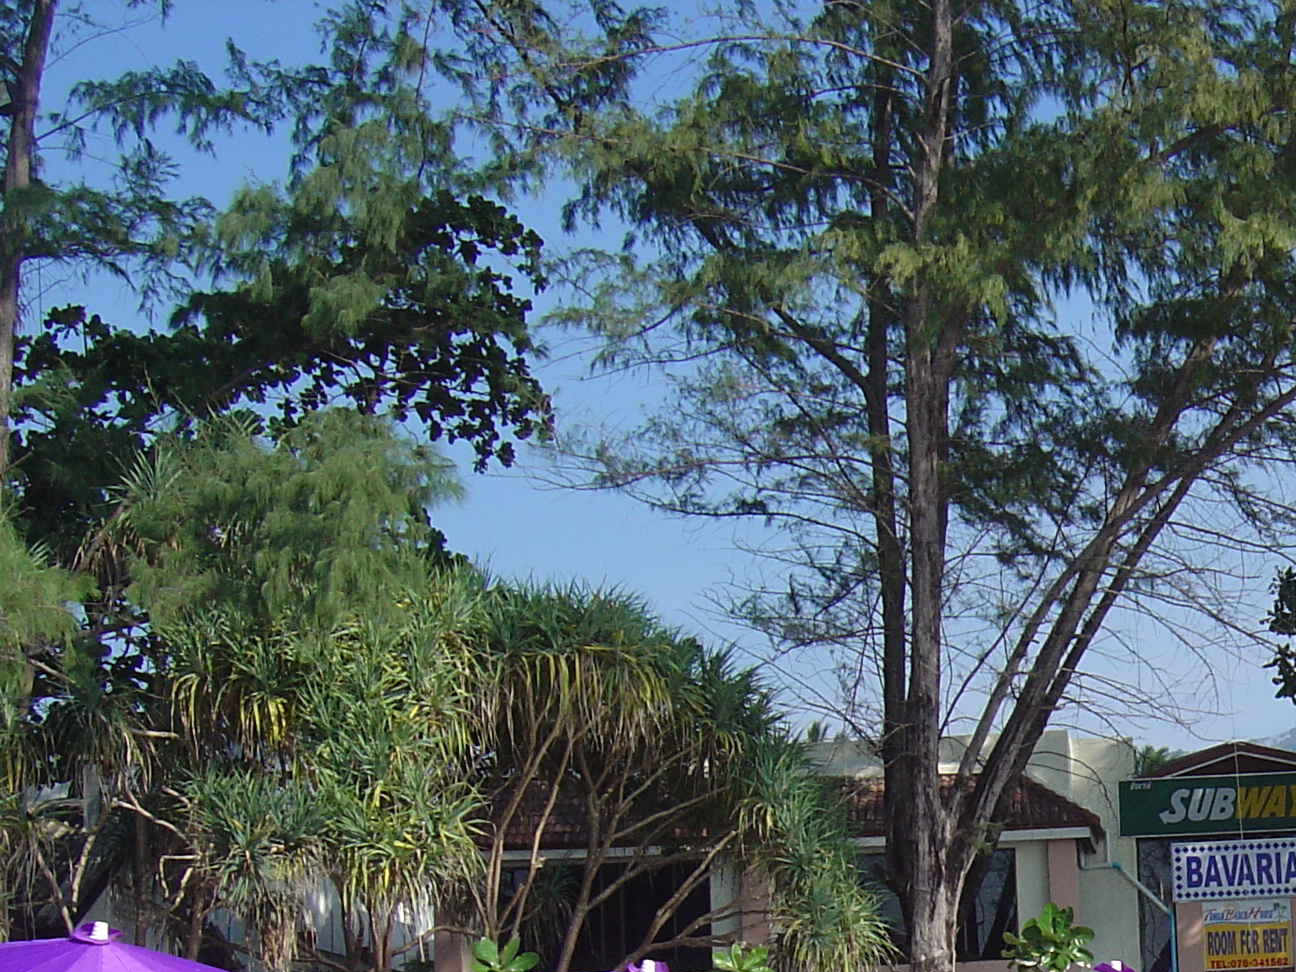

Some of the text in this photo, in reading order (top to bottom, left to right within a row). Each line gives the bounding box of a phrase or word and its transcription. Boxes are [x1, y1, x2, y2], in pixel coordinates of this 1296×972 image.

[1207, 928, 1288, 956] ROOM FOR RENT
